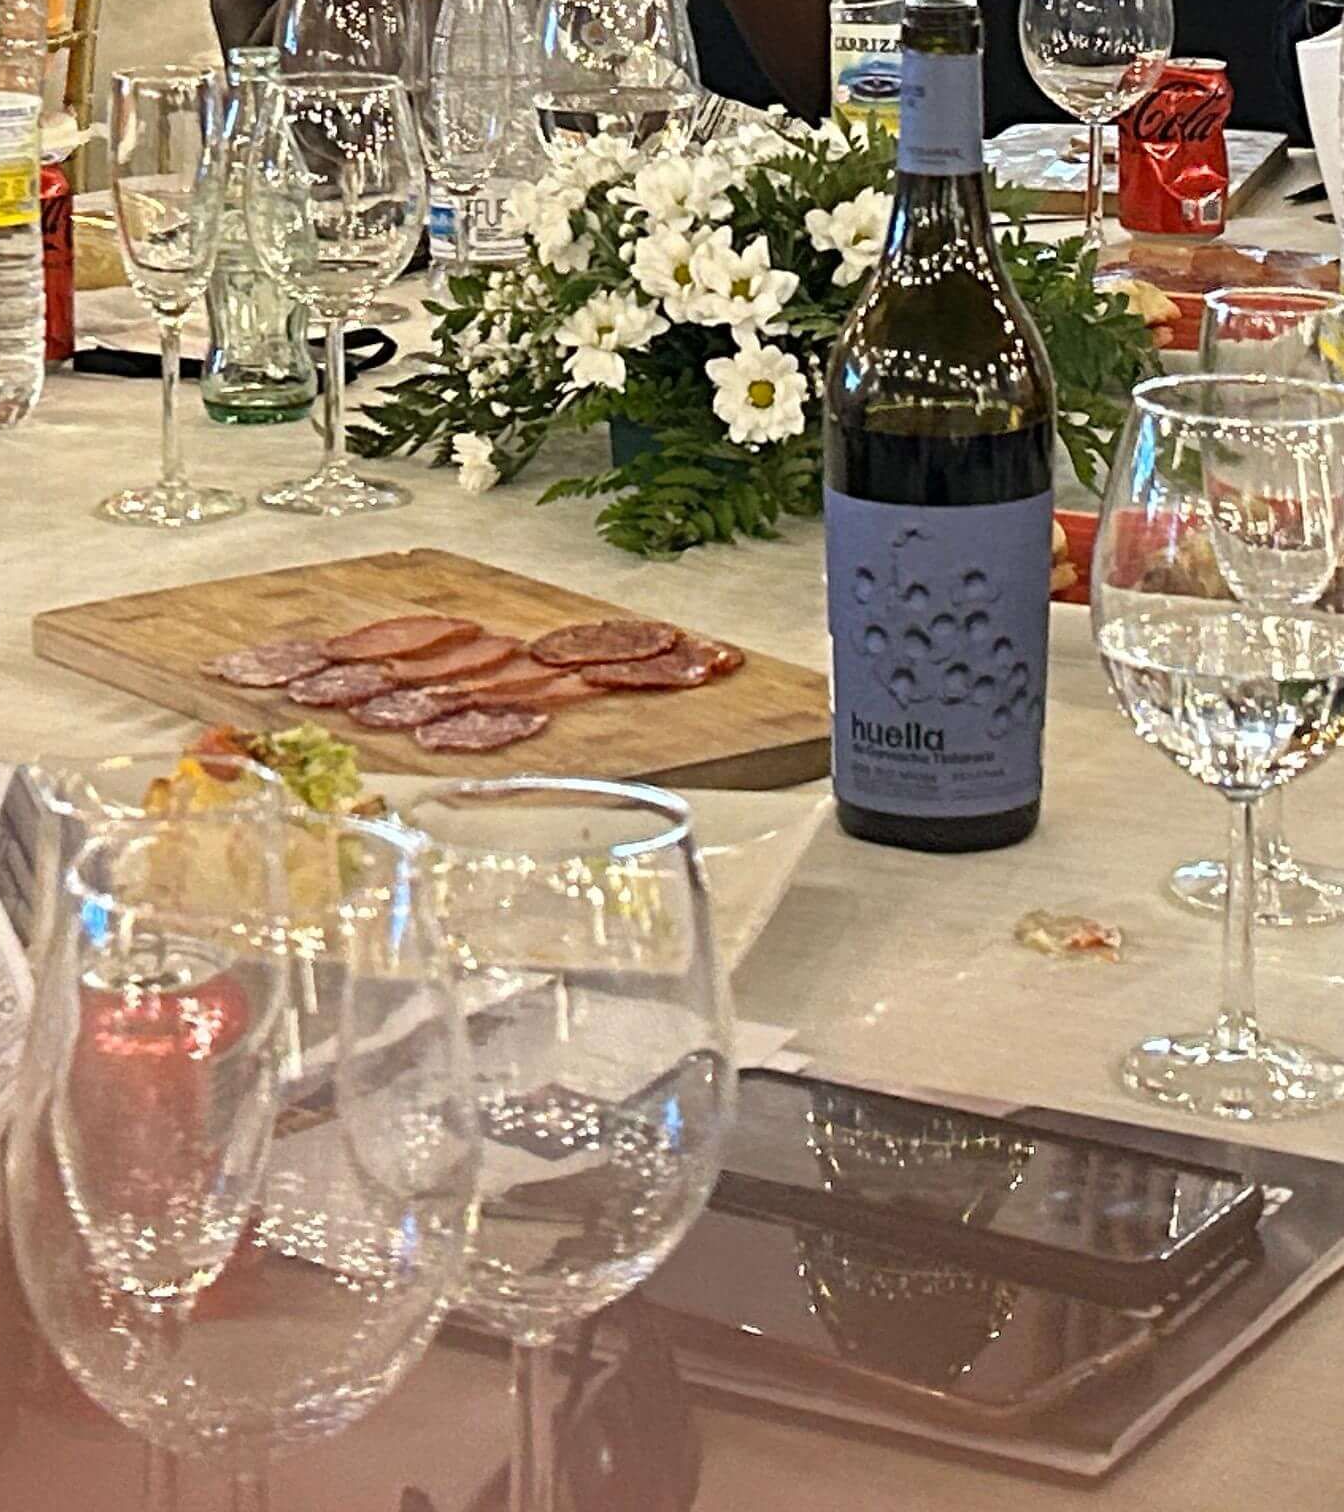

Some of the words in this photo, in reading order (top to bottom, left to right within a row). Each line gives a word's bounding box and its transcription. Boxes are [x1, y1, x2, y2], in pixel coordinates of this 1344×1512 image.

[834, 37, 903, 53] CARRIZA
[1133, 80, 1226, 143] Cola
[851, 711, 945, 751] huella
